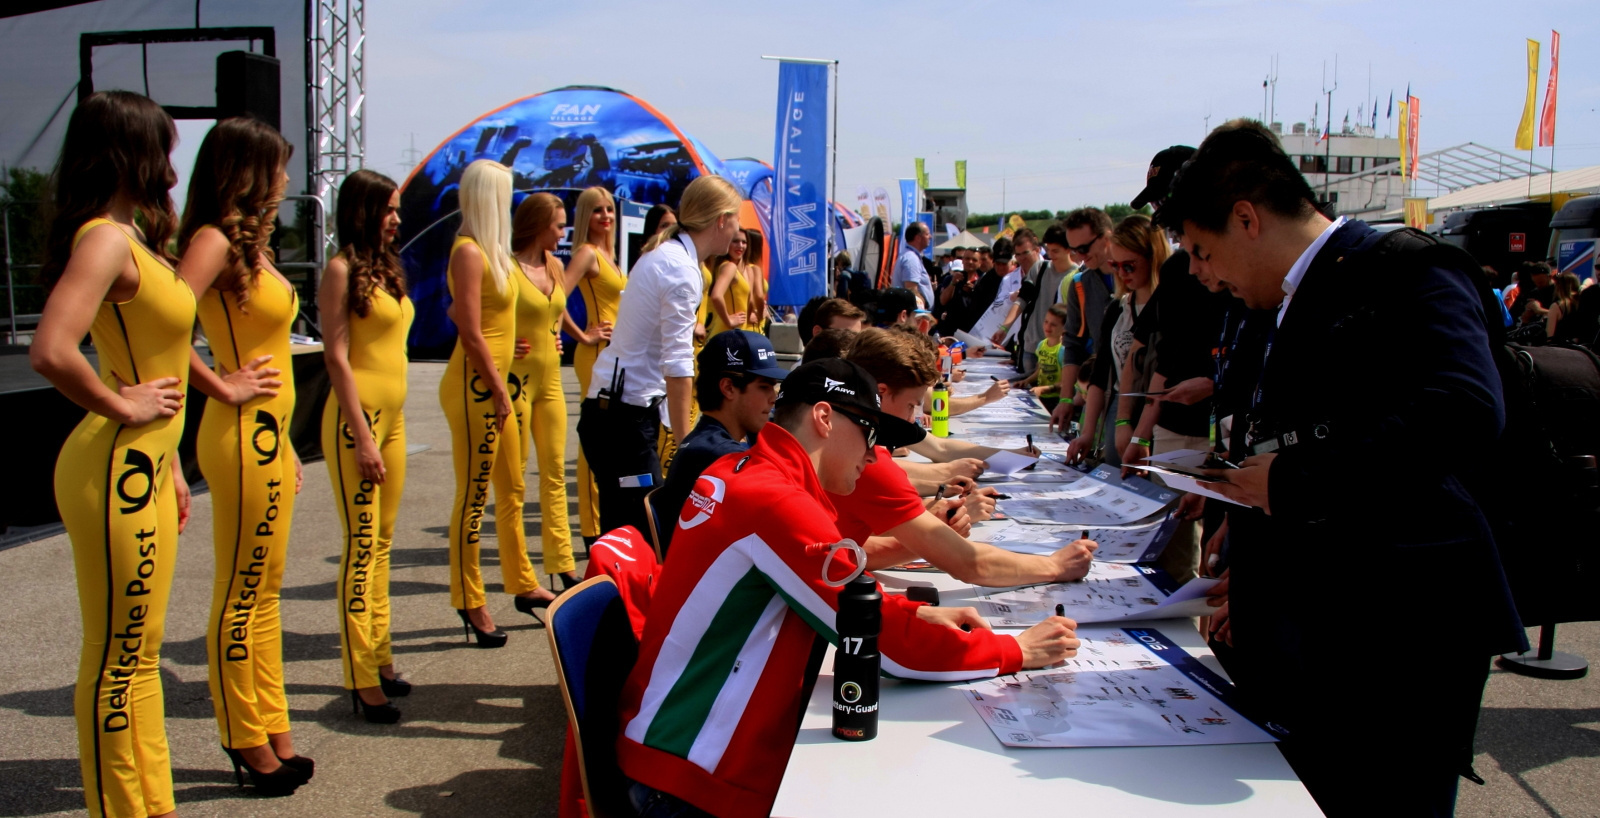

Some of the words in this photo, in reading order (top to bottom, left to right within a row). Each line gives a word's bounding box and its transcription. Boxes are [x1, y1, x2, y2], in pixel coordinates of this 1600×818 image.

[551, 103, 602, 115] FAN
[478, 411, 497, 455] Post
[353, 479, 375, 506] Po
[467, 460, 493, 544] Deutsche
[226, 545, 267, 663] Deutsche
[255, 477, 282, 537] Post
[348, 514, 374, 614] Deutsche
[104, 604, 148, 734] Deutsche
[126, 526, 156, 597] Post
[842, 636, 864, 655] 17
[1129, 630, 1170, 651] 2015
